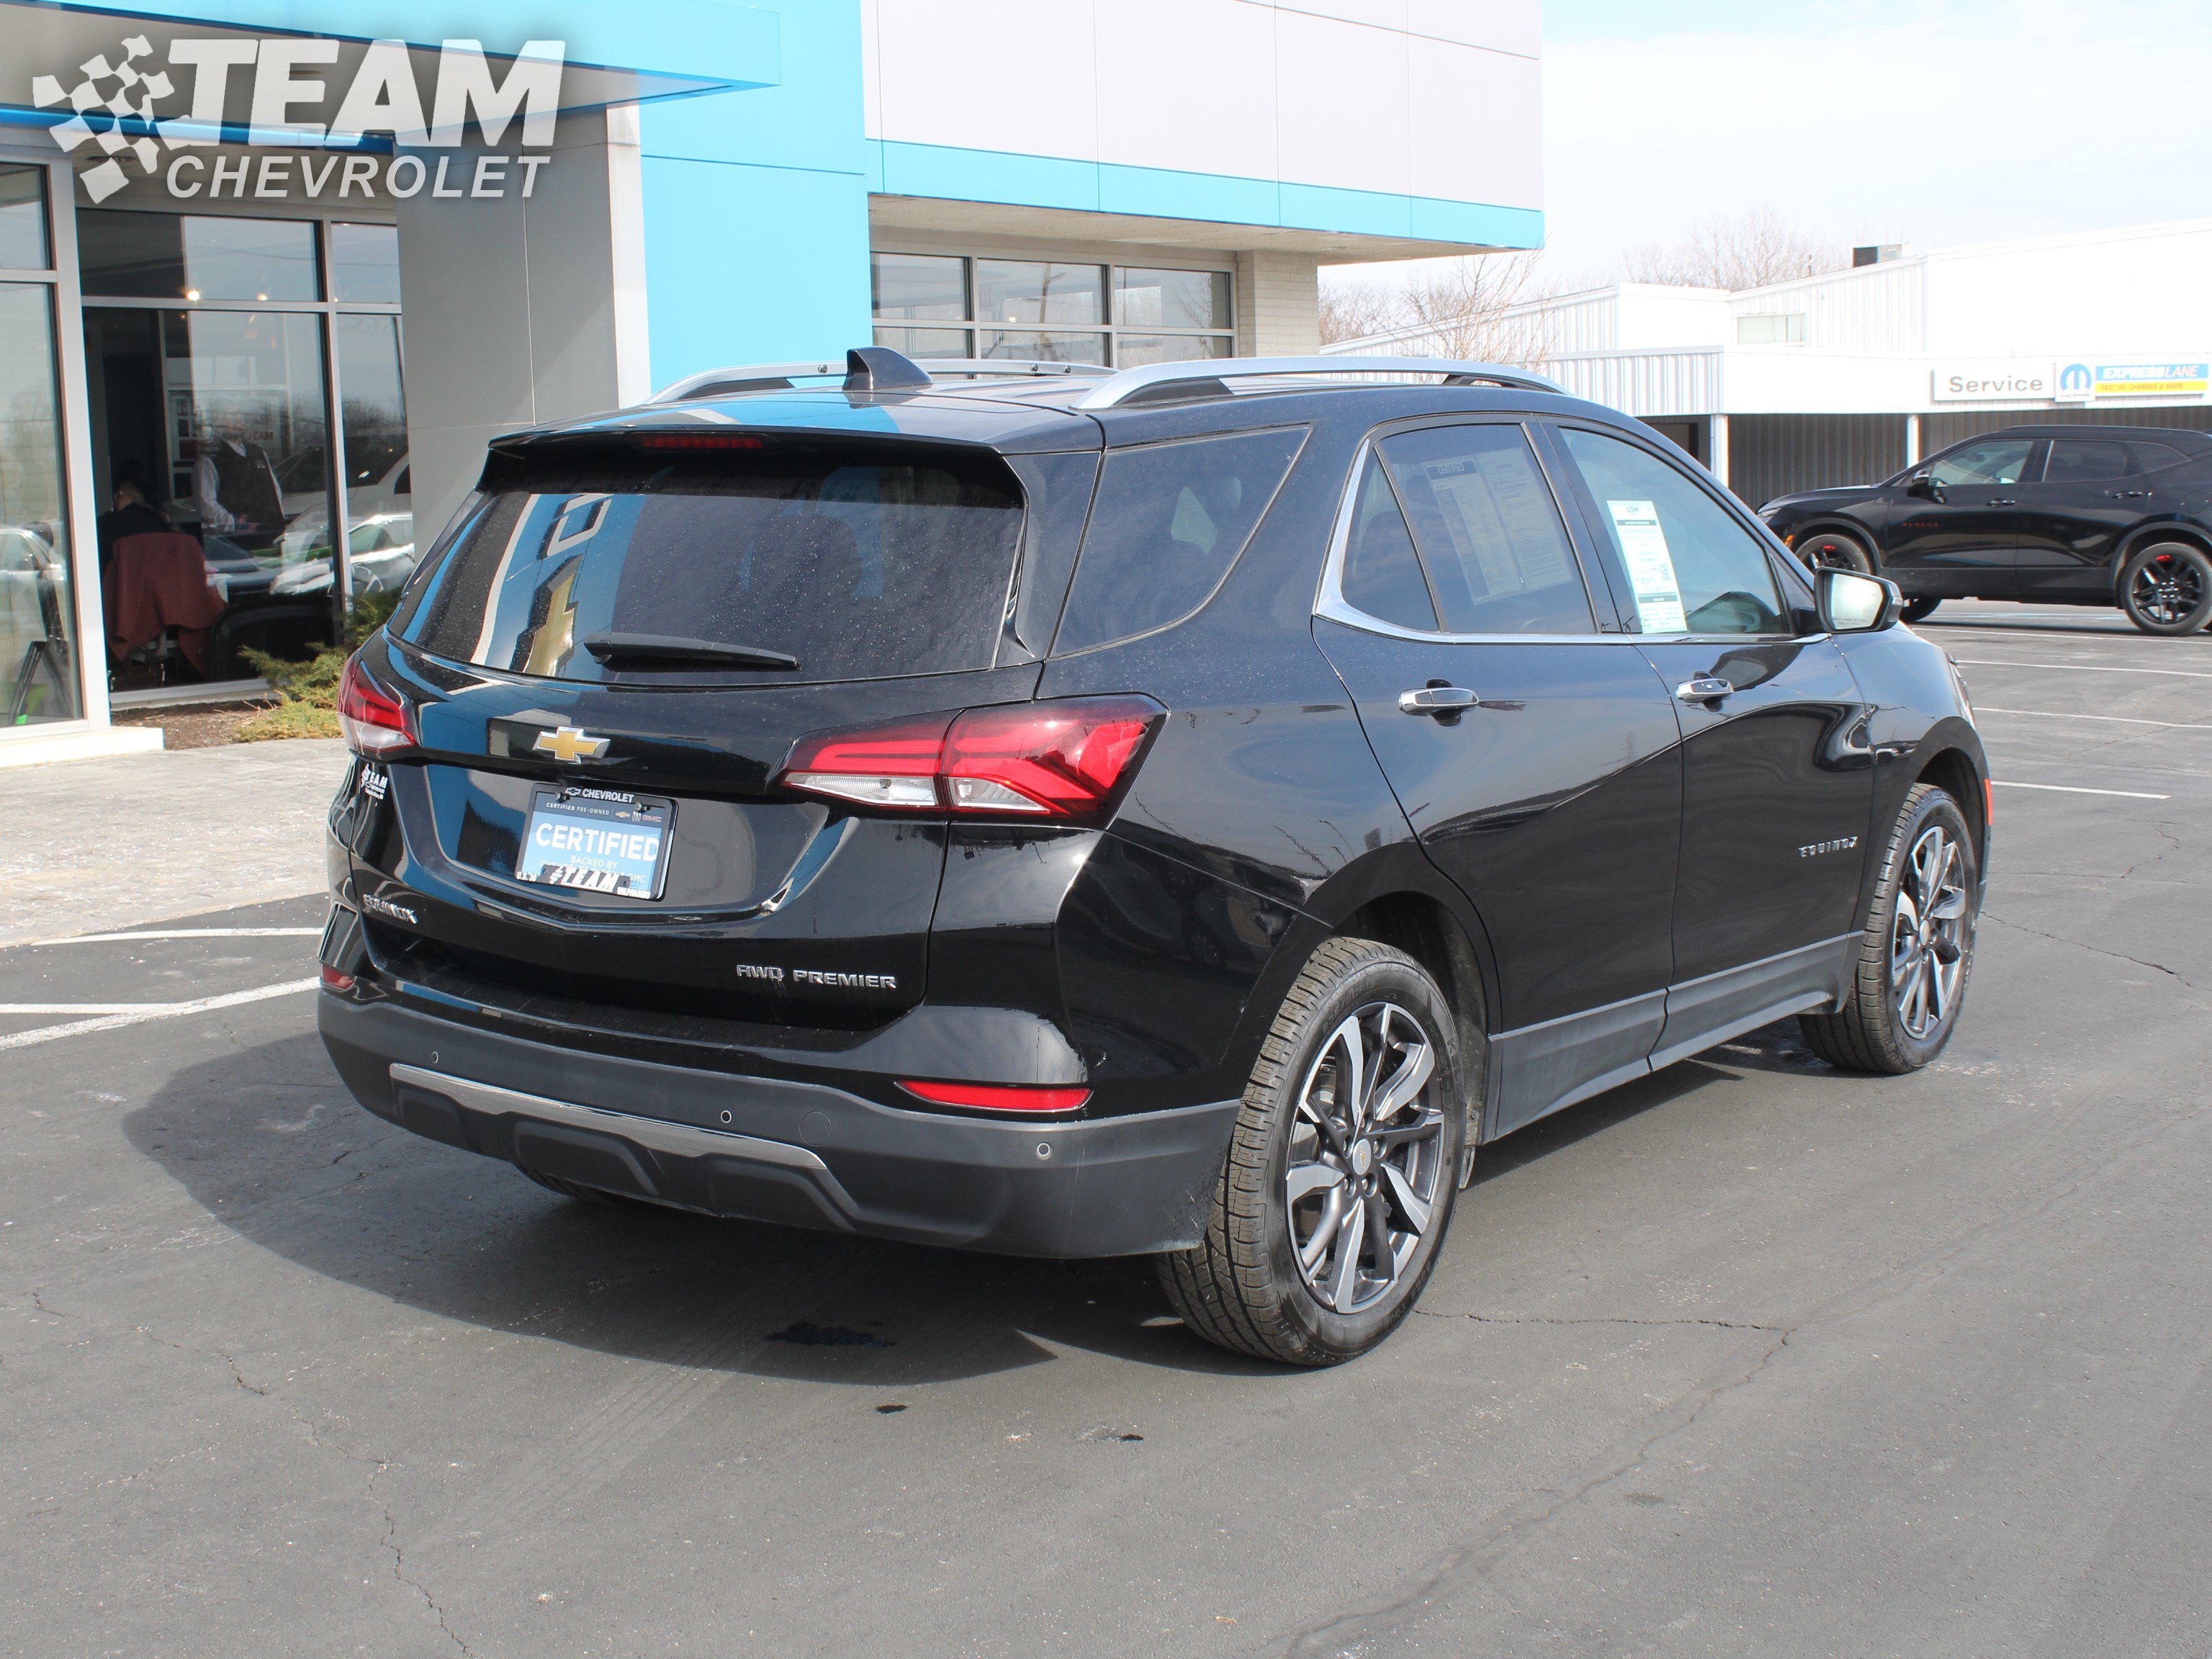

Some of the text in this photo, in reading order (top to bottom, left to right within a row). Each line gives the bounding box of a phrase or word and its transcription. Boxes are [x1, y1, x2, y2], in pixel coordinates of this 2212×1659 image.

[1949, 375, 2043, 392] Service
[582, 788, 634, 804] CHEVROLET
[546, 802, 610, 816] CERTIFIED PRE-OWNED
[536, 822, 660, 862] CERTIFIED
[1798, 836, 1858, 858] EQUINOX
[570, 855, 603, 867] BACKED
[606, 860, 619, 870] BY
[560, 866, 620, 891] TEAM
[736, 964, 896, 989] AWD PREMIER
